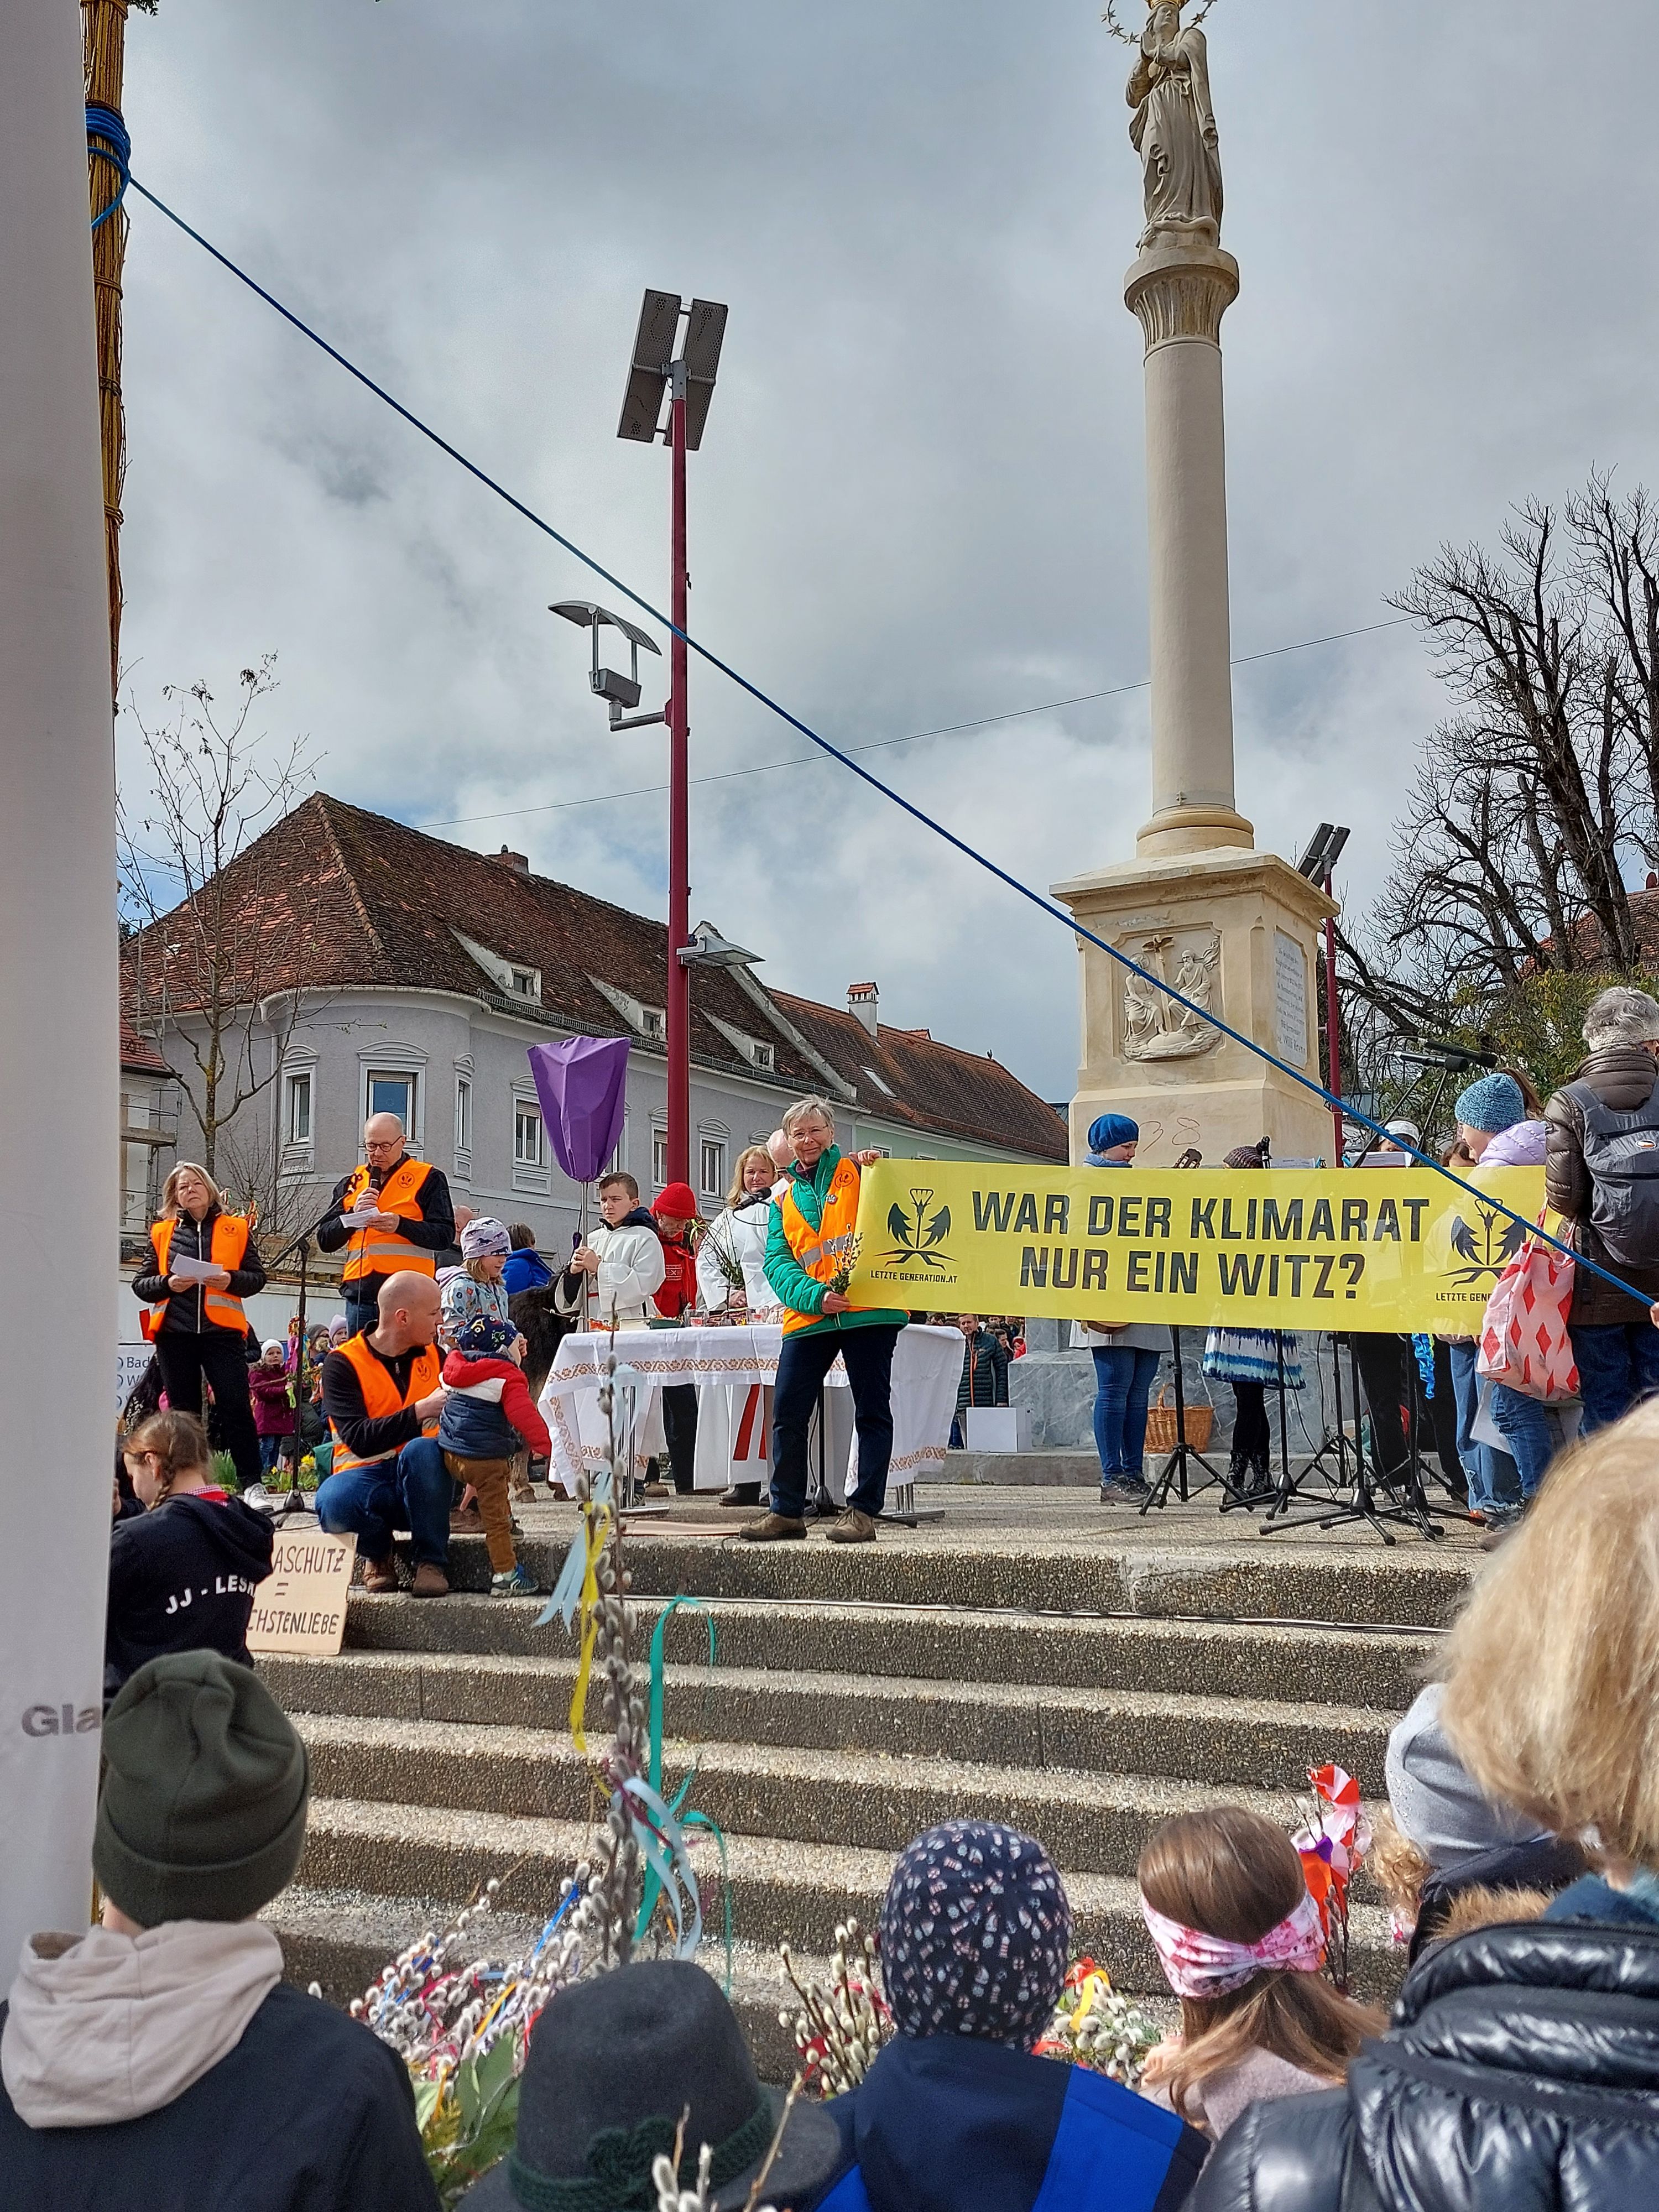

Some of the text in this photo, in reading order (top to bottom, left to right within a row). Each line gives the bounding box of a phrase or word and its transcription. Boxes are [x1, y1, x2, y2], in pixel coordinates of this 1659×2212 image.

[972, 1191, 1430, 1241] WAR DER KLIMARAT
[871, 1270, 958, 1284] LETZTE GENERATION.AT
[1020, 1246, 1366, 1299] NUR EIN WITZ?
[1436, 1293, 1467, 1301] LETZTE
[273, 1546, 346, 1574] ASCHUTZ
[165, 1588, 192, 1614] JJ
